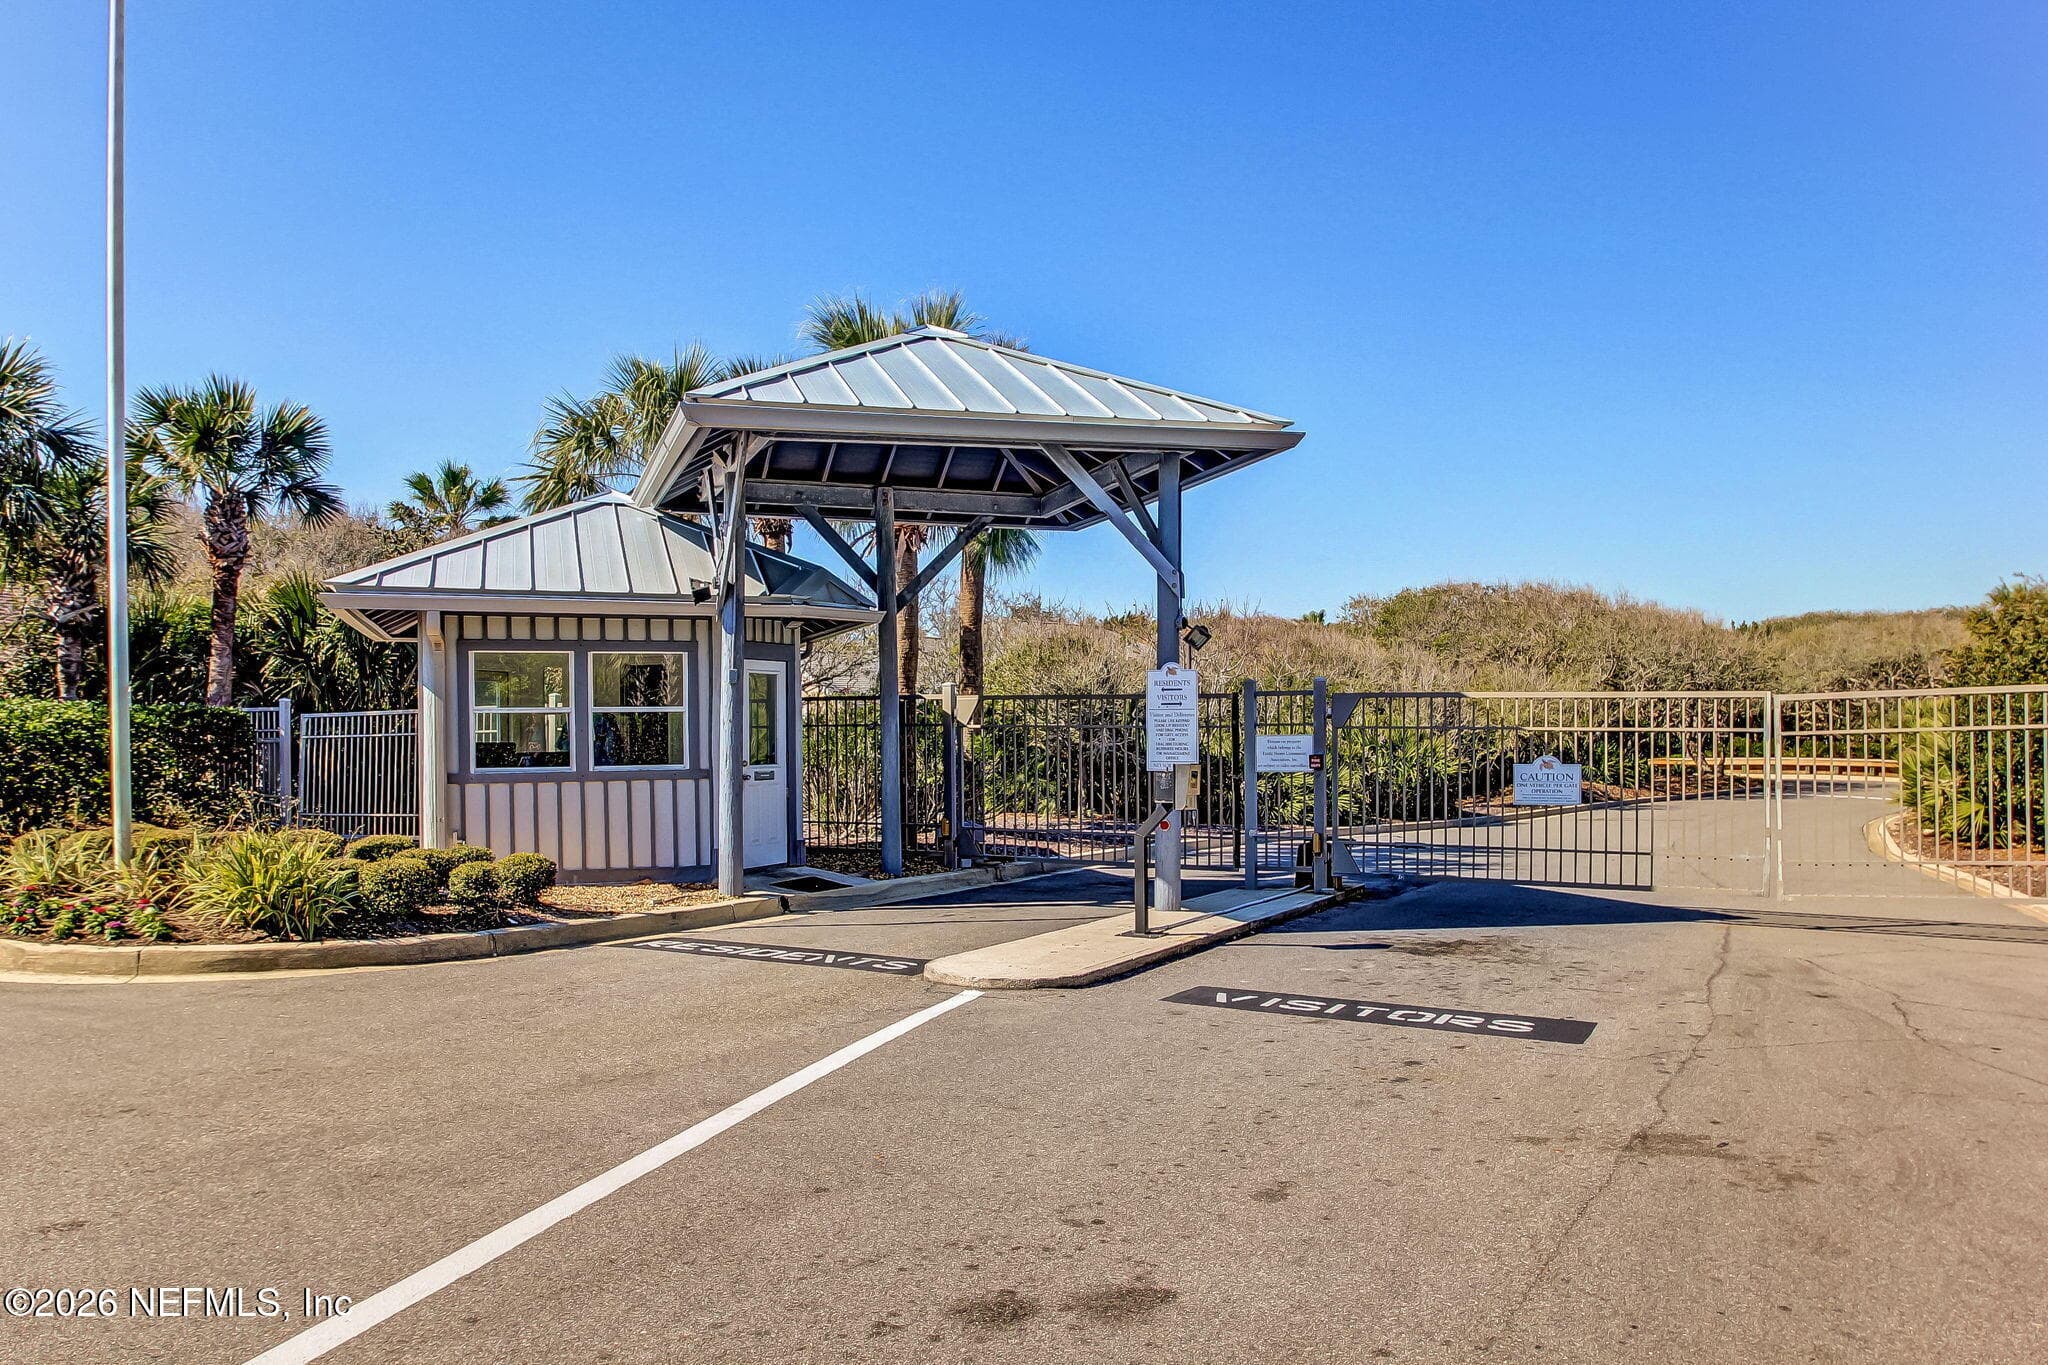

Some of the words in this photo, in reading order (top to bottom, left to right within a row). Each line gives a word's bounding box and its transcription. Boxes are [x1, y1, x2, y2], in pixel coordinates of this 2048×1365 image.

[1153, 679, 1191, 687] RESIDENTS
[1519, 772, 1574, 782] CAUTION
[632, 939, 918, 971] RESIDENTS
[1215, 991, 1537, 1033] VISITORS
